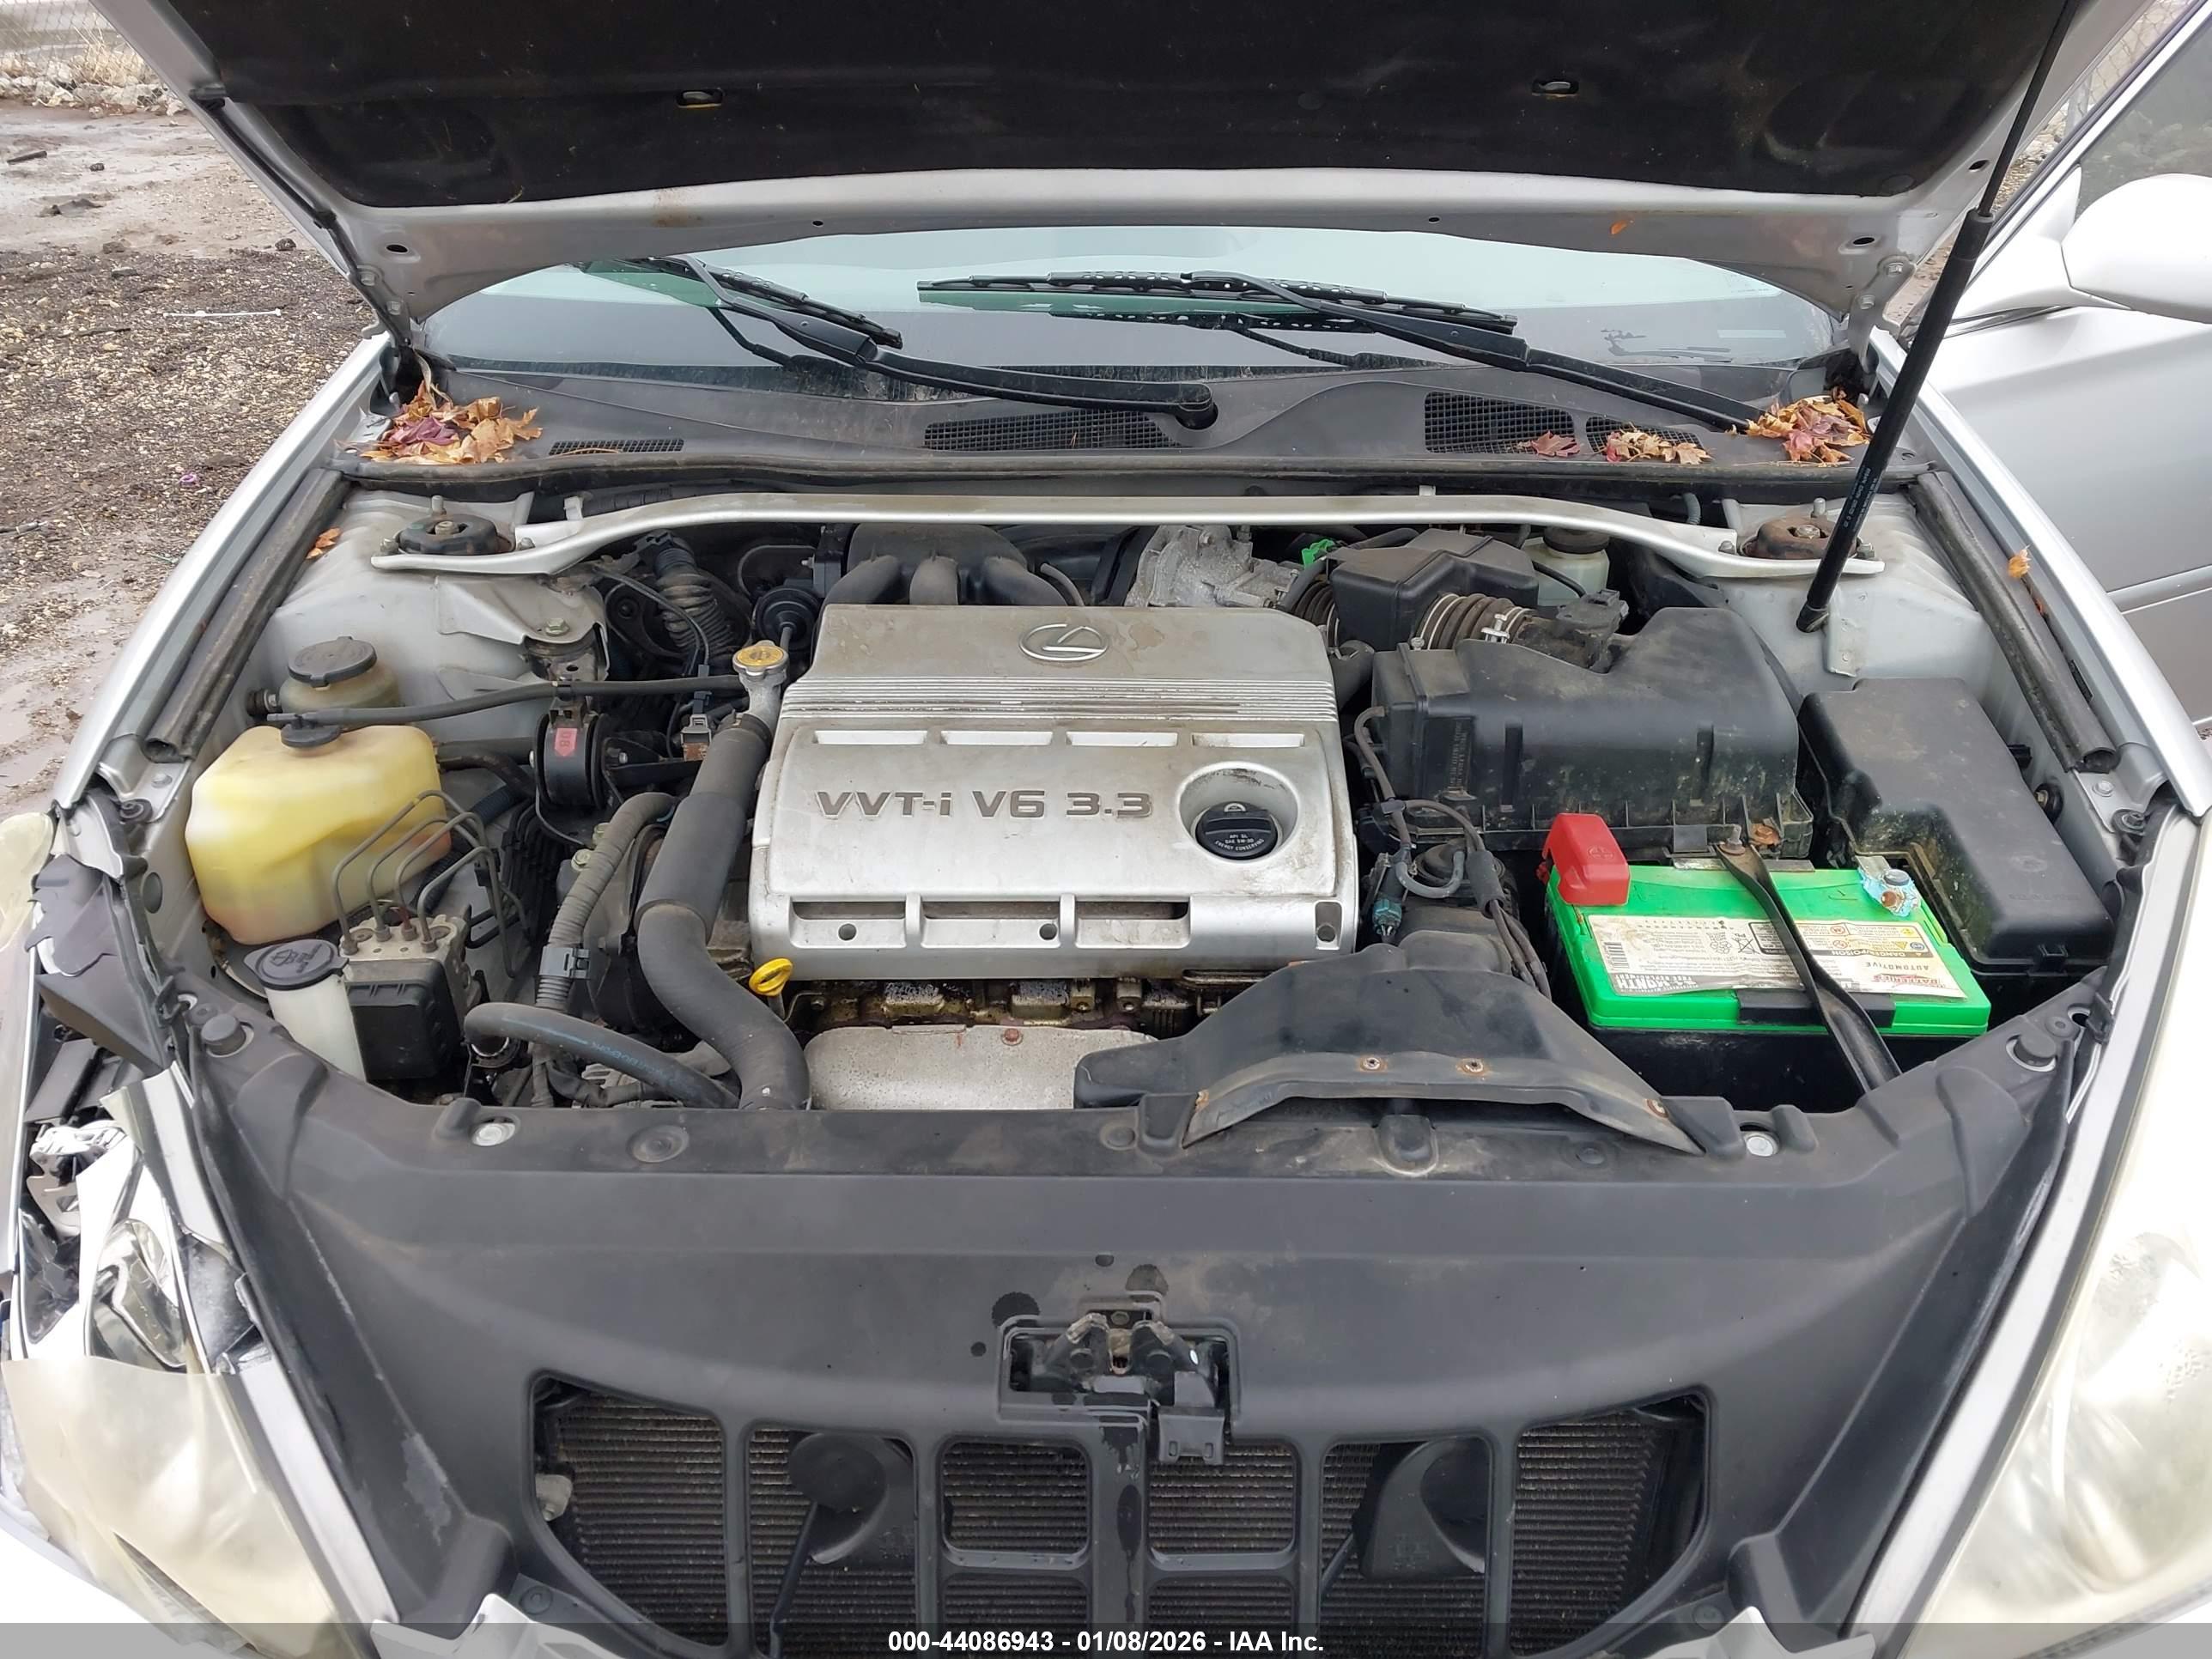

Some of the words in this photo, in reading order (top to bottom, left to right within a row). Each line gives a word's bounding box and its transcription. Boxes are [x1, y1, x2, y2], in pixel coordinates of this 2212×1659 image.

[815, 790, 951, 818] VVT-i
[972, 789, 1046, 819] V6
[1066, 791, 1152, 818] 3.3
[1214, 840, 1234, 851] ENERGY
[1235, 838, 1265, 851] CONSERVING
[1832, 949, 1906, 958] DANGER/POISON
[1866, 962, 1929, 971] AUTOMOTIVE
[1872, 975, 1939, 984] BATTERIES
